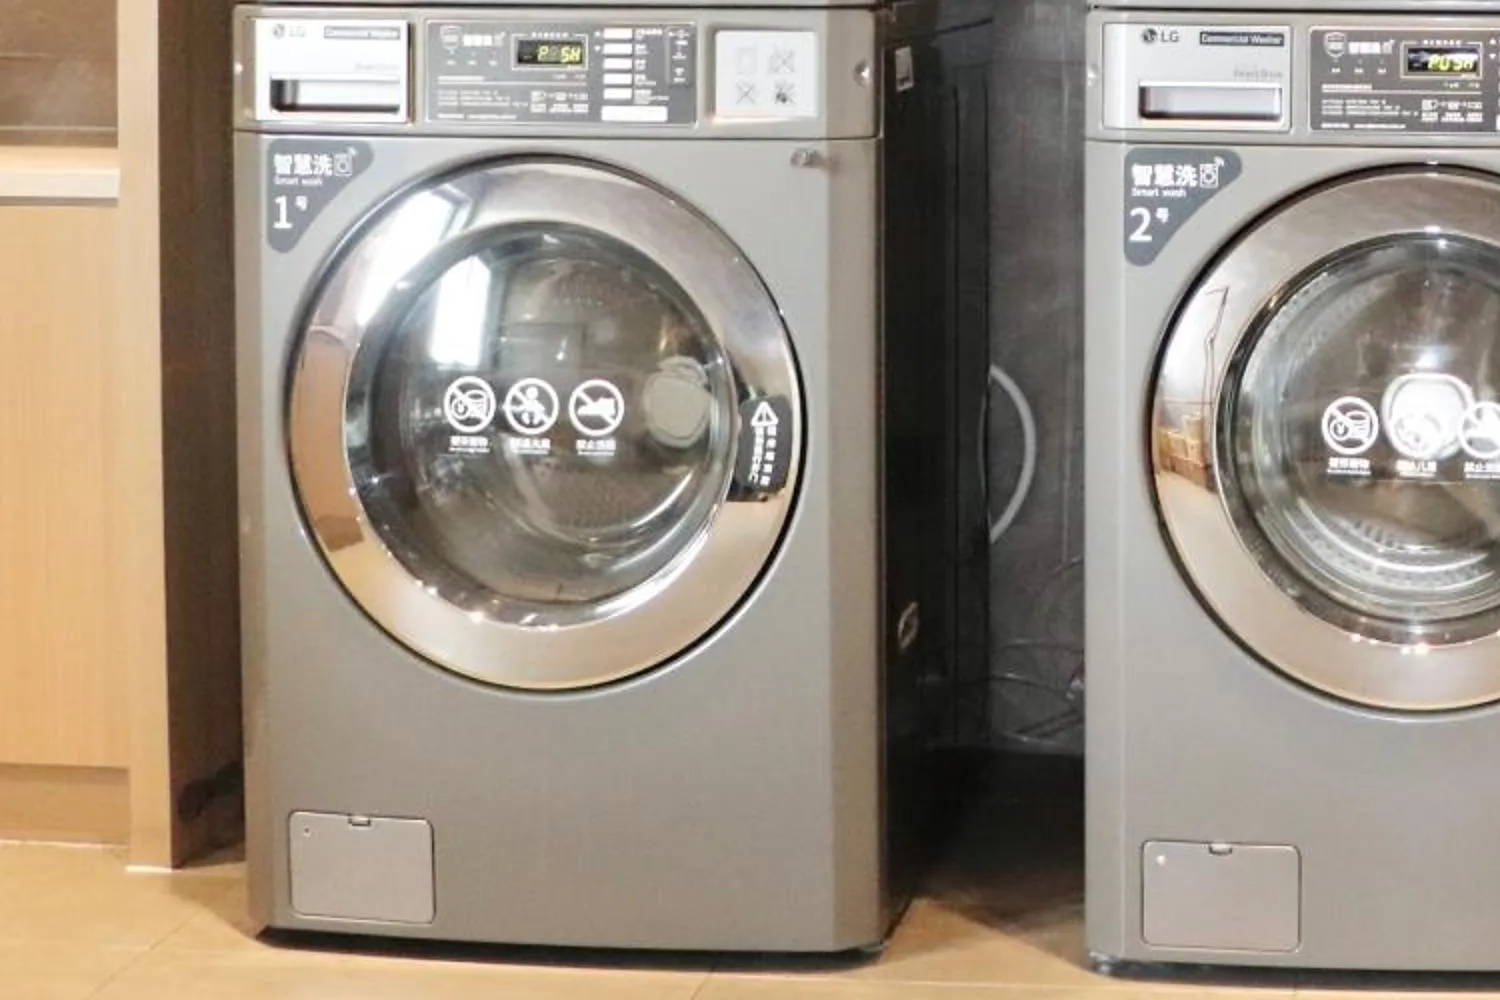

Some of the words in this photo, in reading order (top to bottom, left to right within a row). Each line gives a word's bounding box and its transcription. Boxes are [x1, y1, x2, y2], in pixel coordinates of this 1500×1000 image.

[1161, 31, 1180, 43] LG
[274, 152, 333, 176] 智慧洗
[1132, 163, 1198, 187] 智慧洗
